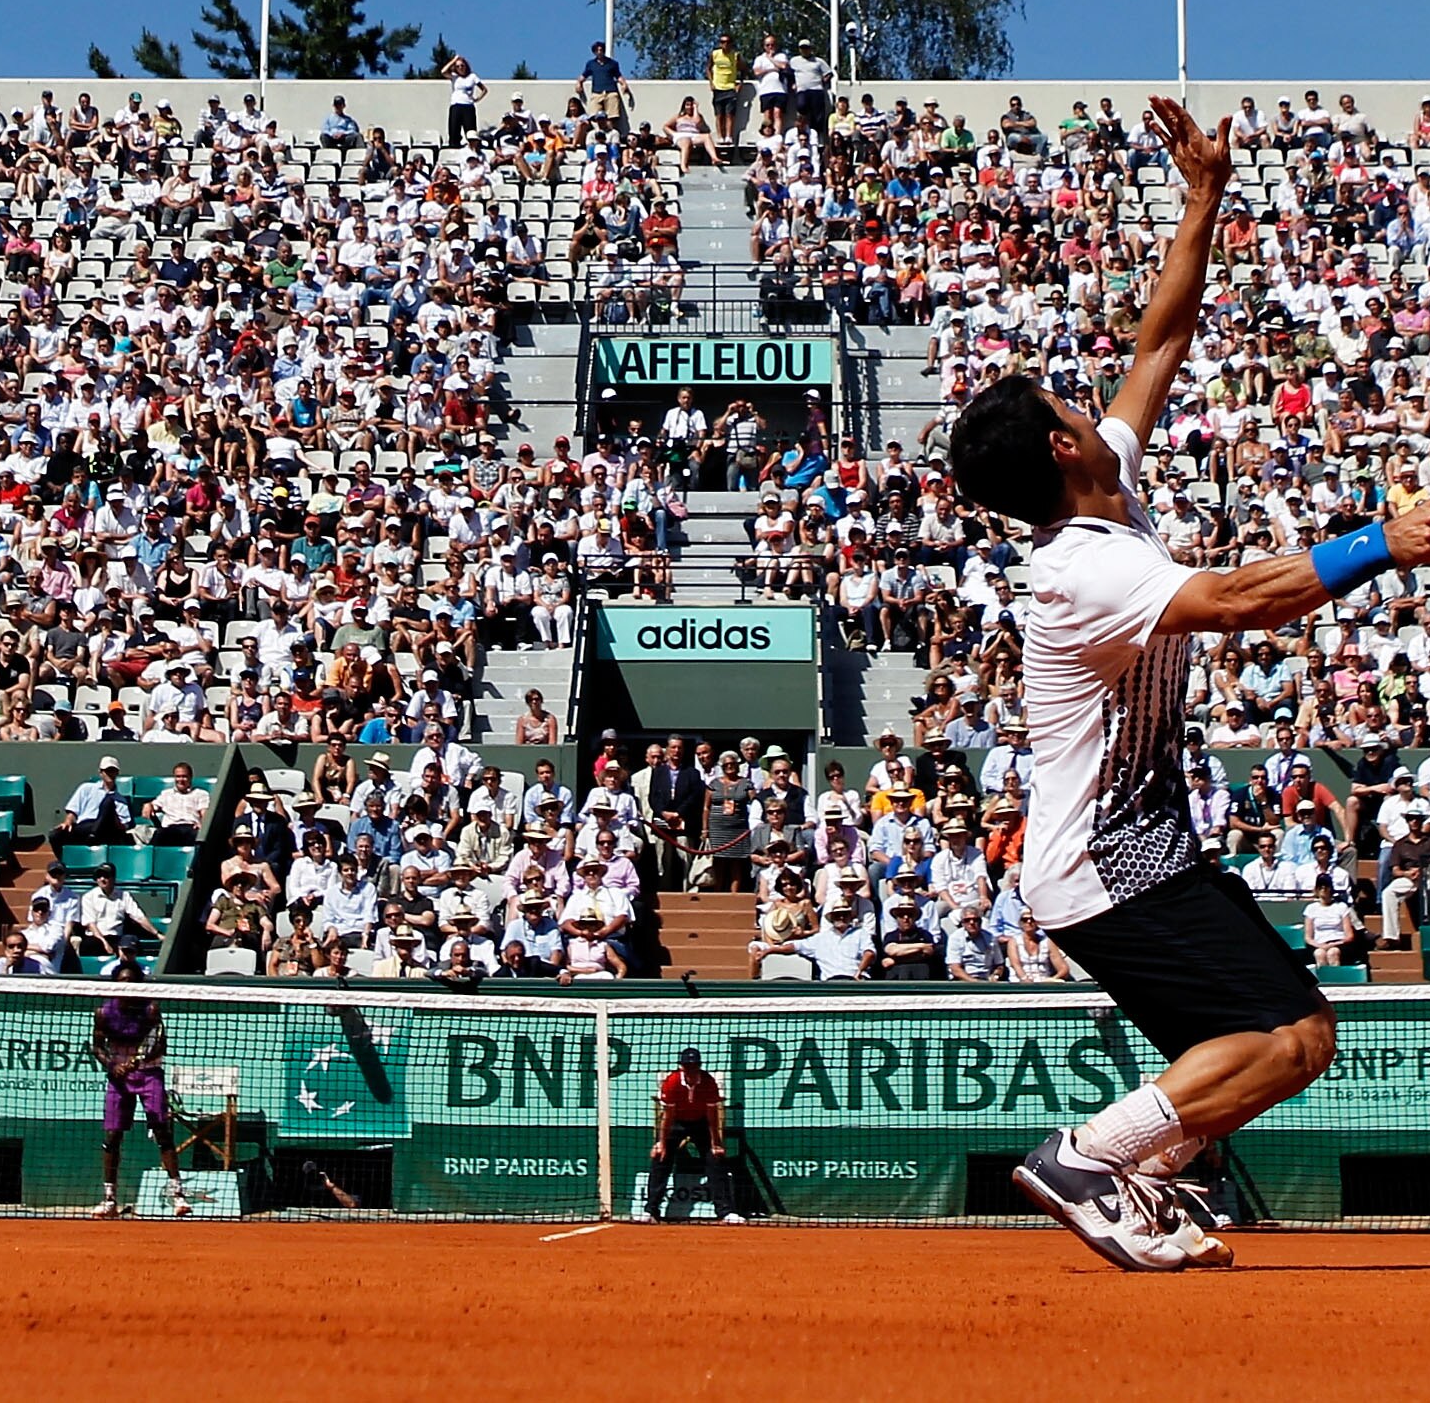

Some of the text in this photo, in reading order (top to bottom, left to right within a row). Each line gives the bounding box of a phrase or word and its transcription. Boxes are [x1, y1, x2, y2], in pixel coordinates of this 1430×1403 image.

[620, 342, 812, 382] AFFLELOU
[637, 618, 771, 649] adidas
[447, 1034, 1118, 1114] BNP PARIBAS
[444, 1157, 588, 1176] BNP PARIBAS
[772, 1160, 918, 1180] BNP PARIBAS
